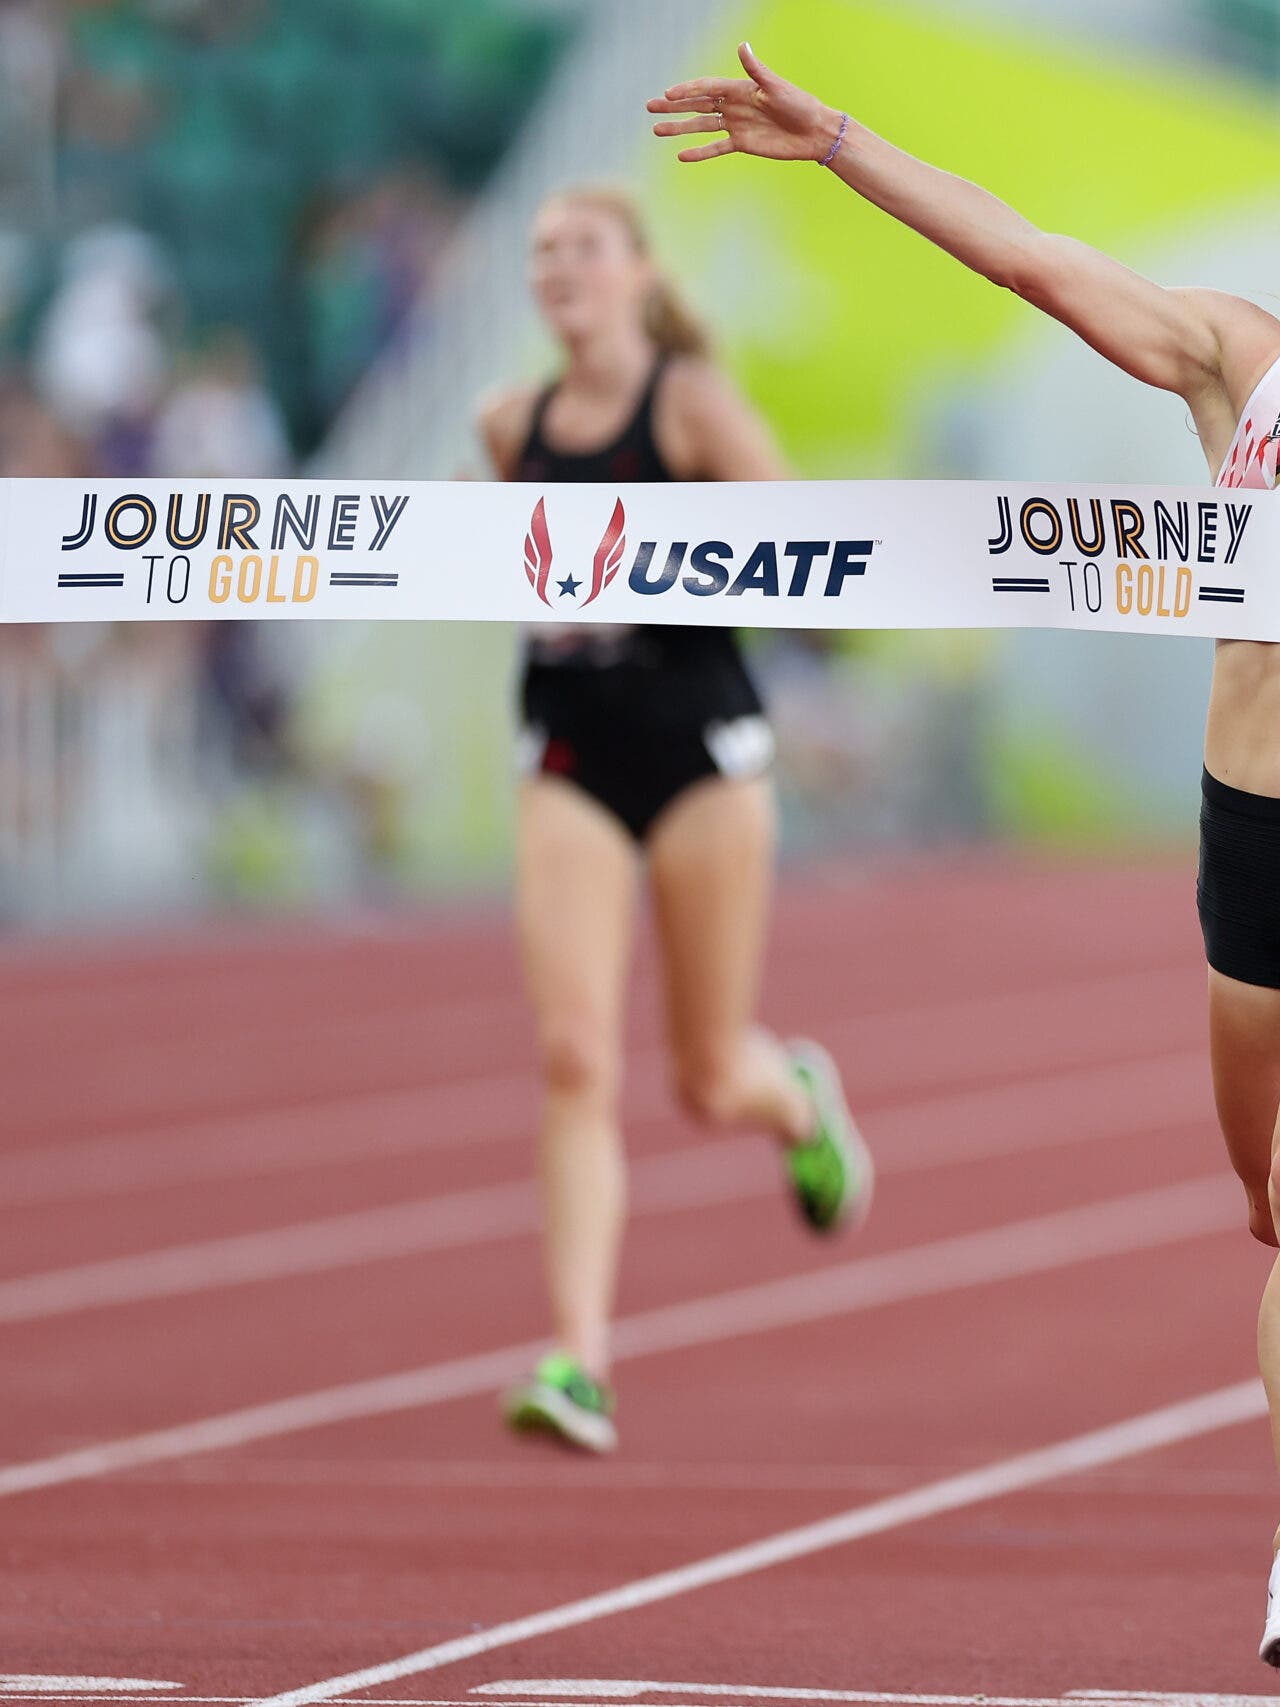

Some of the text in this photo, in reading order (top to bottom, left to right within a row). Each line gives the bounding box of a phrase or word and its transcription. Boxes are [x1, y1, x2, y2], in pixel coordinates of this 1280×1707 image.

[61, 493, 410, 551] JOURNEY
[987, 496, 1253, 564] JOURNEY
[142, 555, 320, 604] TO GOLD
[628, 540, 874, 597] USATF
[1059, 561, 1193, 618] TO GOLD
